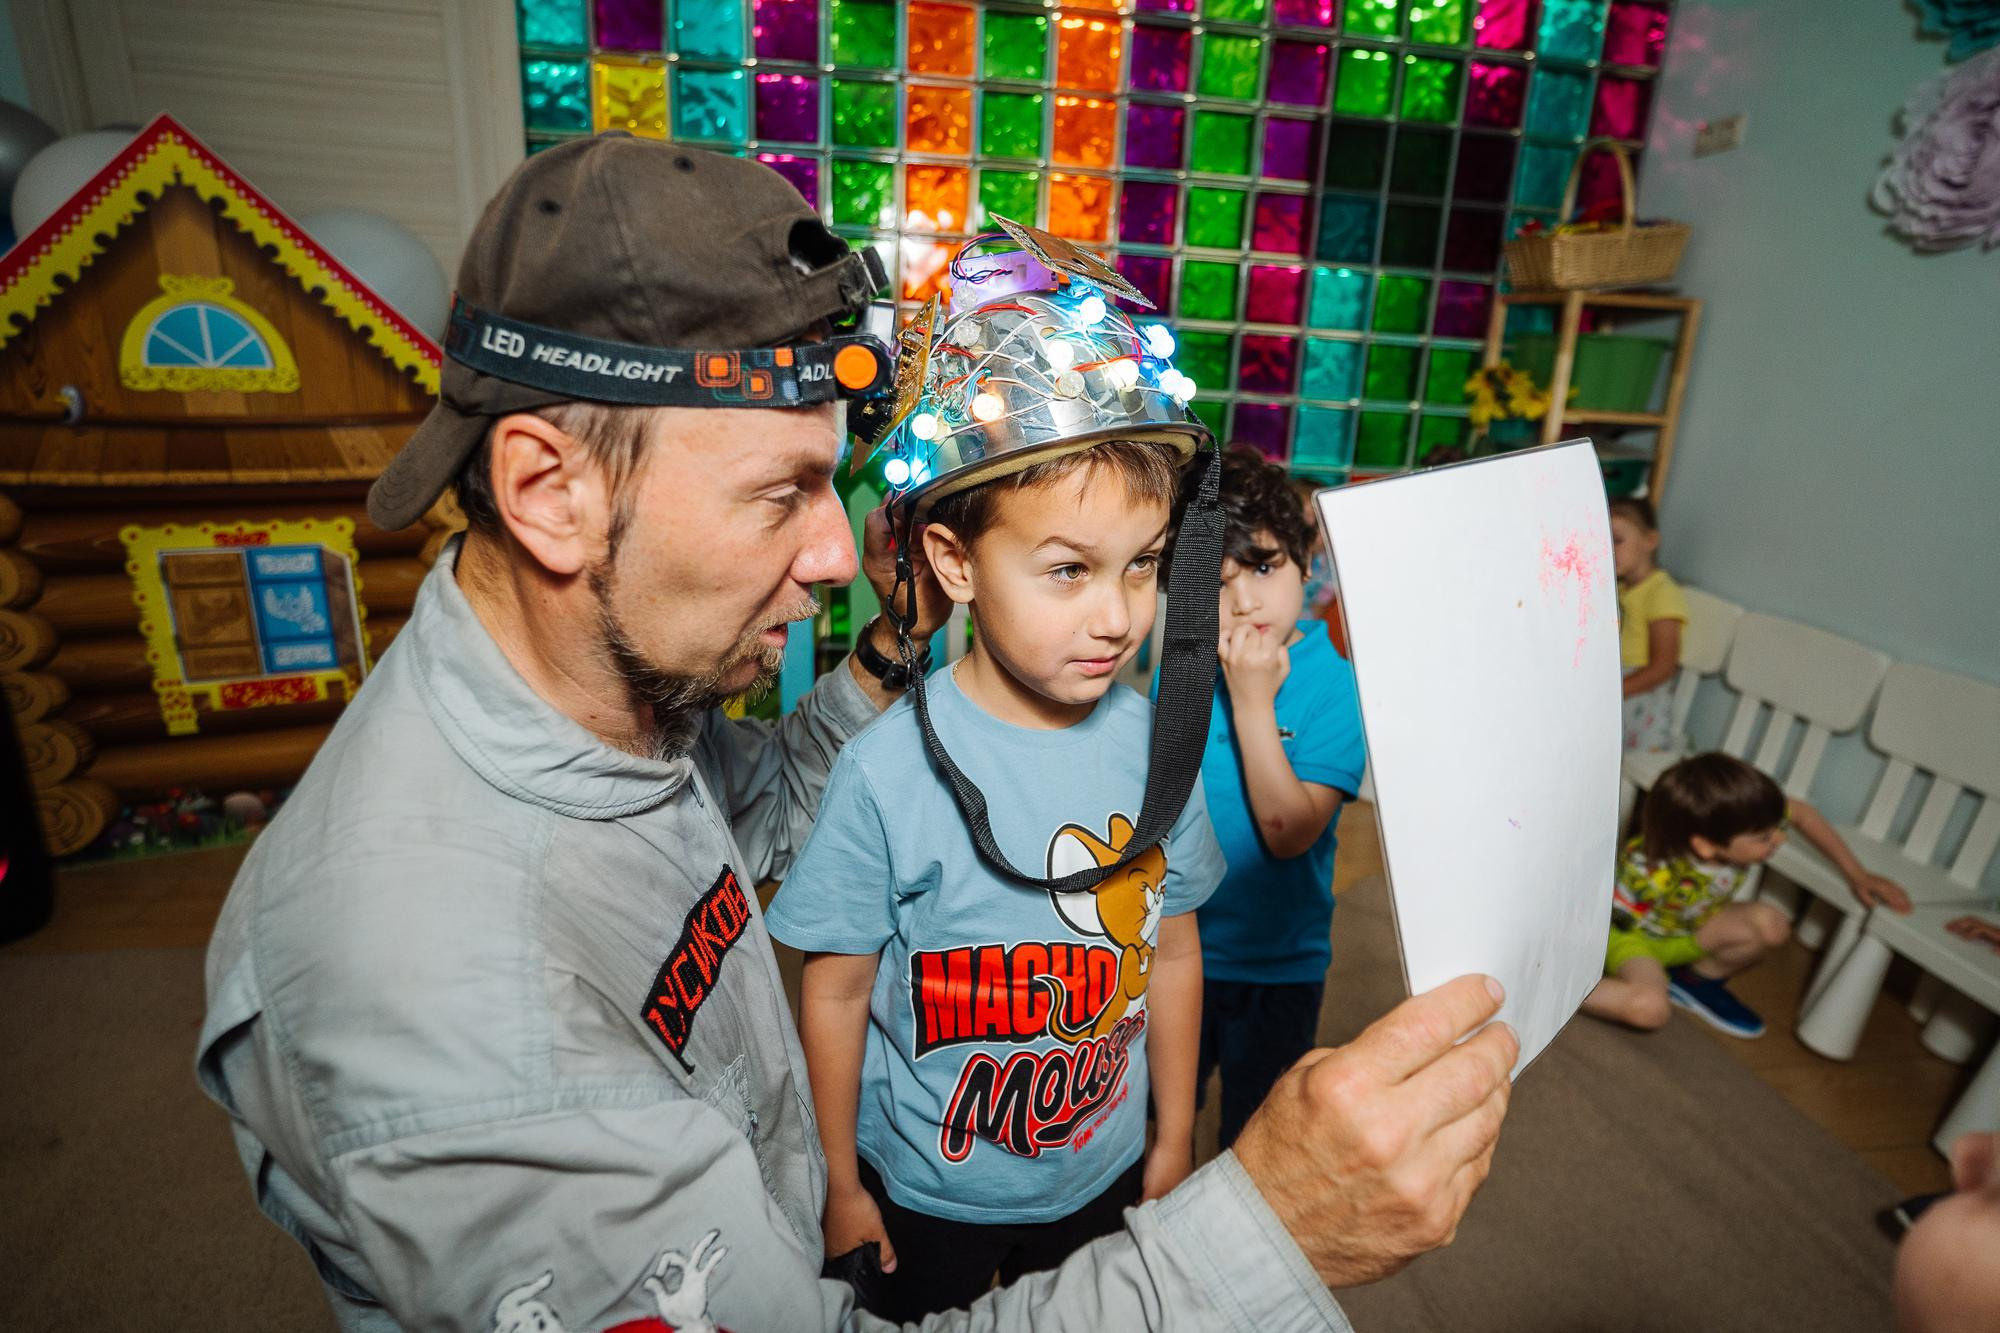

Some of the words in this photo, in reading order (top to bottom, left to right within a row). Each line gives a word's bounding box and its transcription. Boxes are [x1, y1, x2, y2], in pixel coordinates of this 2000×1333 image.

[481, 325, 525, 358] LED
[531, 343, 684, 383] HEADLIGHT
[911, 942, 1120, 1058] MACHO
